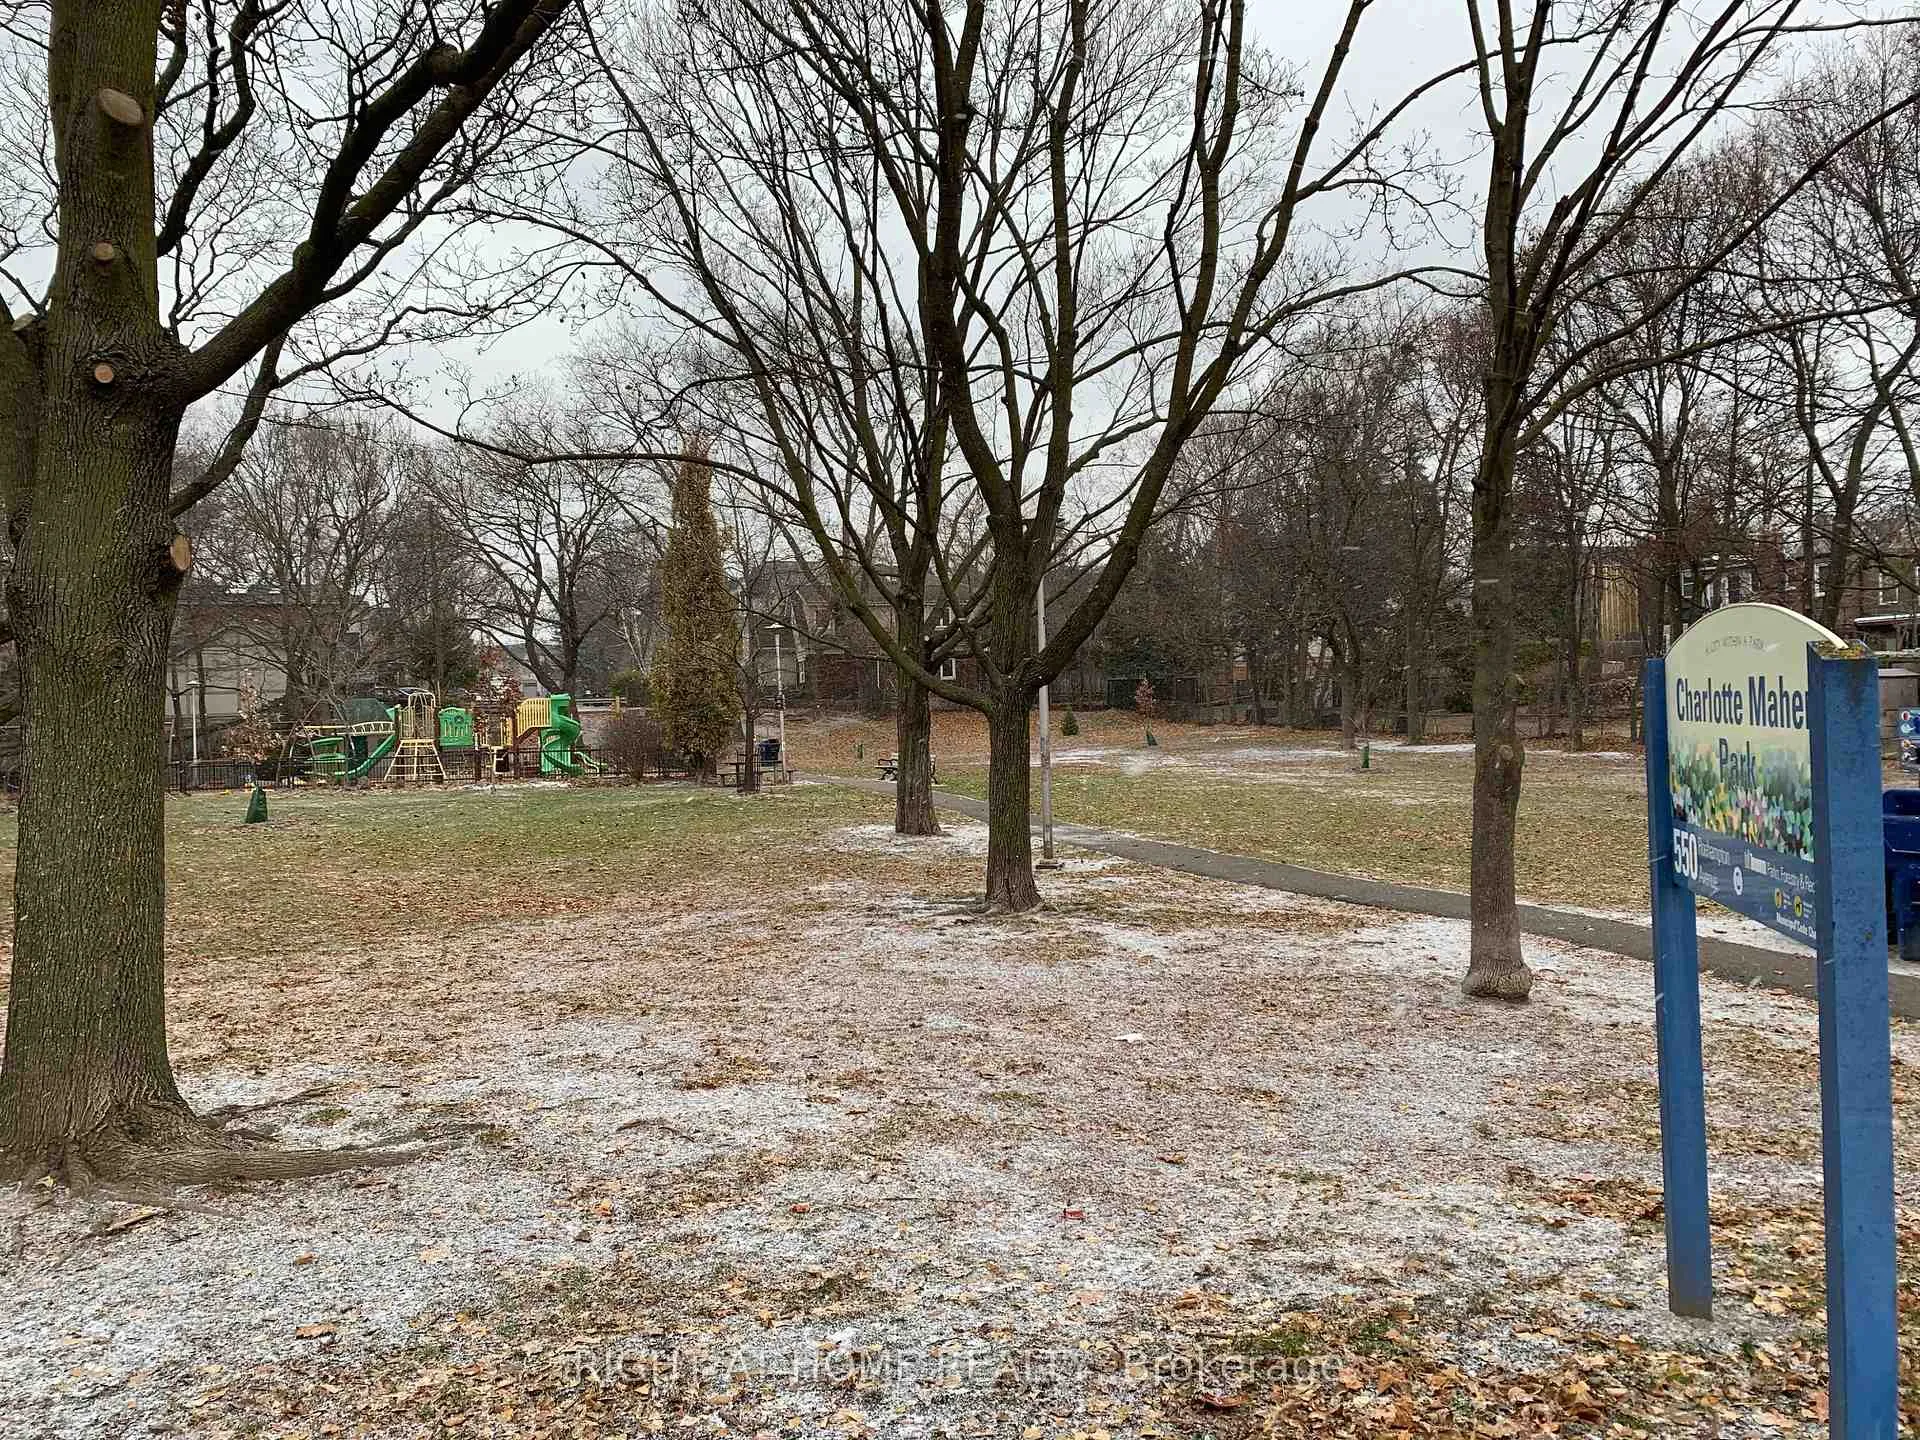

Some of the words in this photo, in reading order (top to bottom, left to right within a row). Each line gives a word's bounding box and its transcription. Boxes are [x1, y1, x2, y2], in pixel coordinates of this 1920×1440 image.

[1677, 677, 1743, 725] Charlotte
[1719, 738, 1757, 789] Park
[1673, 828, 1698, 881] 550
